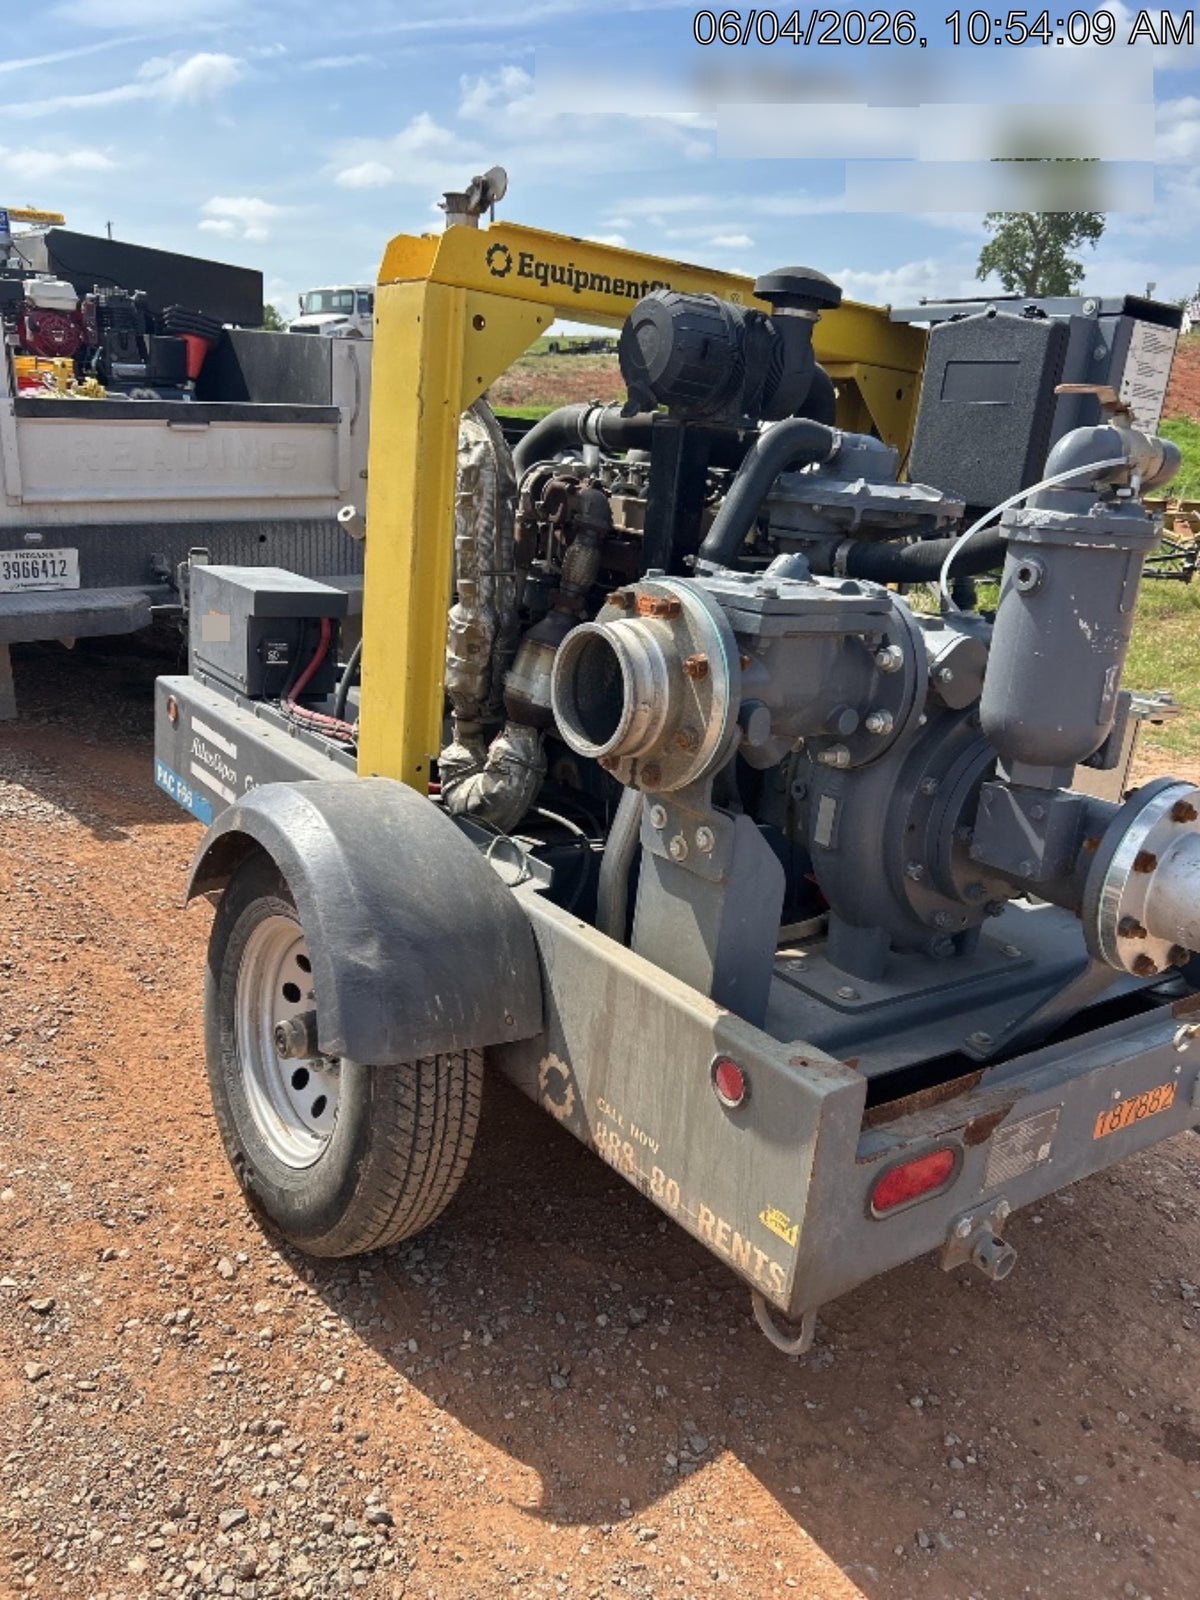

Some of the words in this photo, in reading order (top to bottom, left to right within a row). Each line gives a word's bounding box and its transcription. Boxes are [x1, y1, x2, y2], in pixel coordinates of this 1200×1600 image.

[72, 440, 298, 472] READING
[2, 559, 68, 580] 3966412
[596, 1096, 625, 1130] CALL
